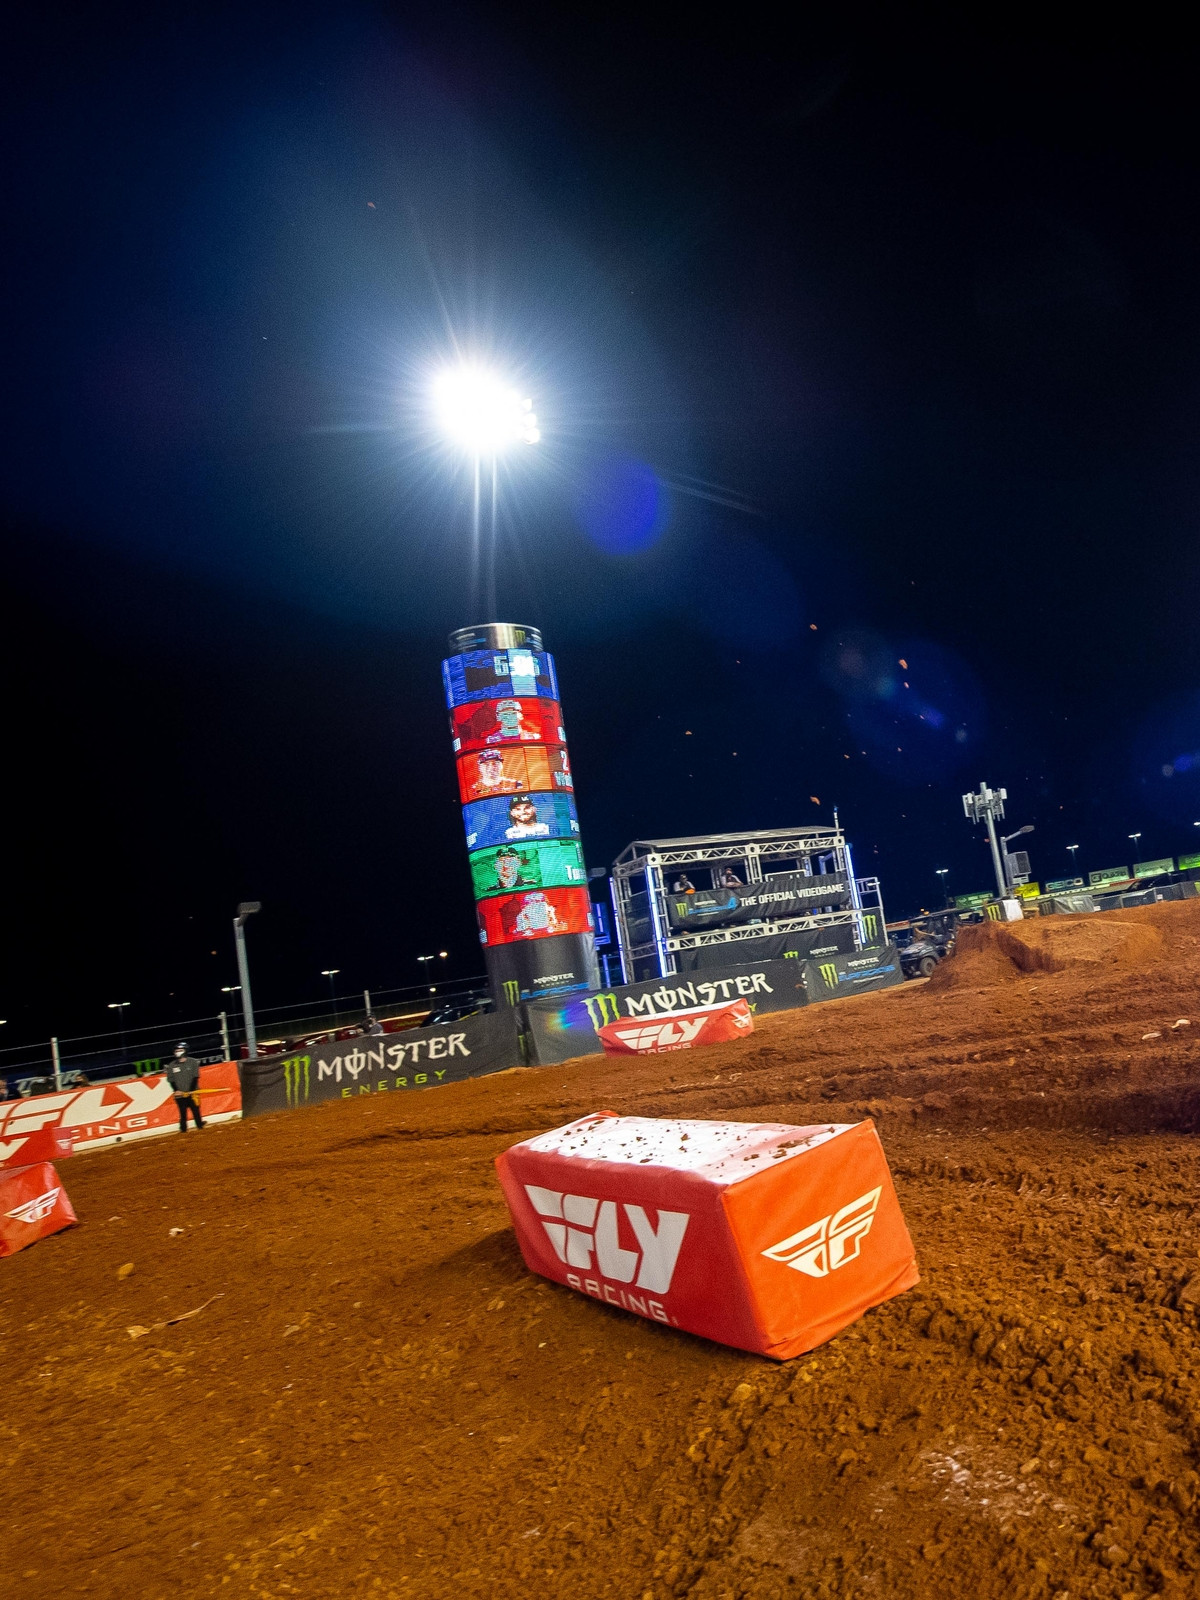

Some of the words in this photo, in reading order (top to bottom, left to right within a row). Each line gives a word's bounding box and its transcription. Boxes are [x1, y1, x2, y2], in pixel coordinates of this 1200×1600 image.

[740, 896, 757, 907] THE
[758, 891, 796, 905] OFFICIAL
[797, 883, 845, 899] VIDEOGAME
[624, 972, 774, 1017] MONSTER
[614, 1016, 709, 1050] FLY
[637, 1042, 692, 1055] RACING
[317, 1032, 471, 1083] MONSTER
[341, 1069, 447, 1098] ENERGY
[523, 1184, 690, 1294] FLY
[567, 1272, 669, 1324] RACING
